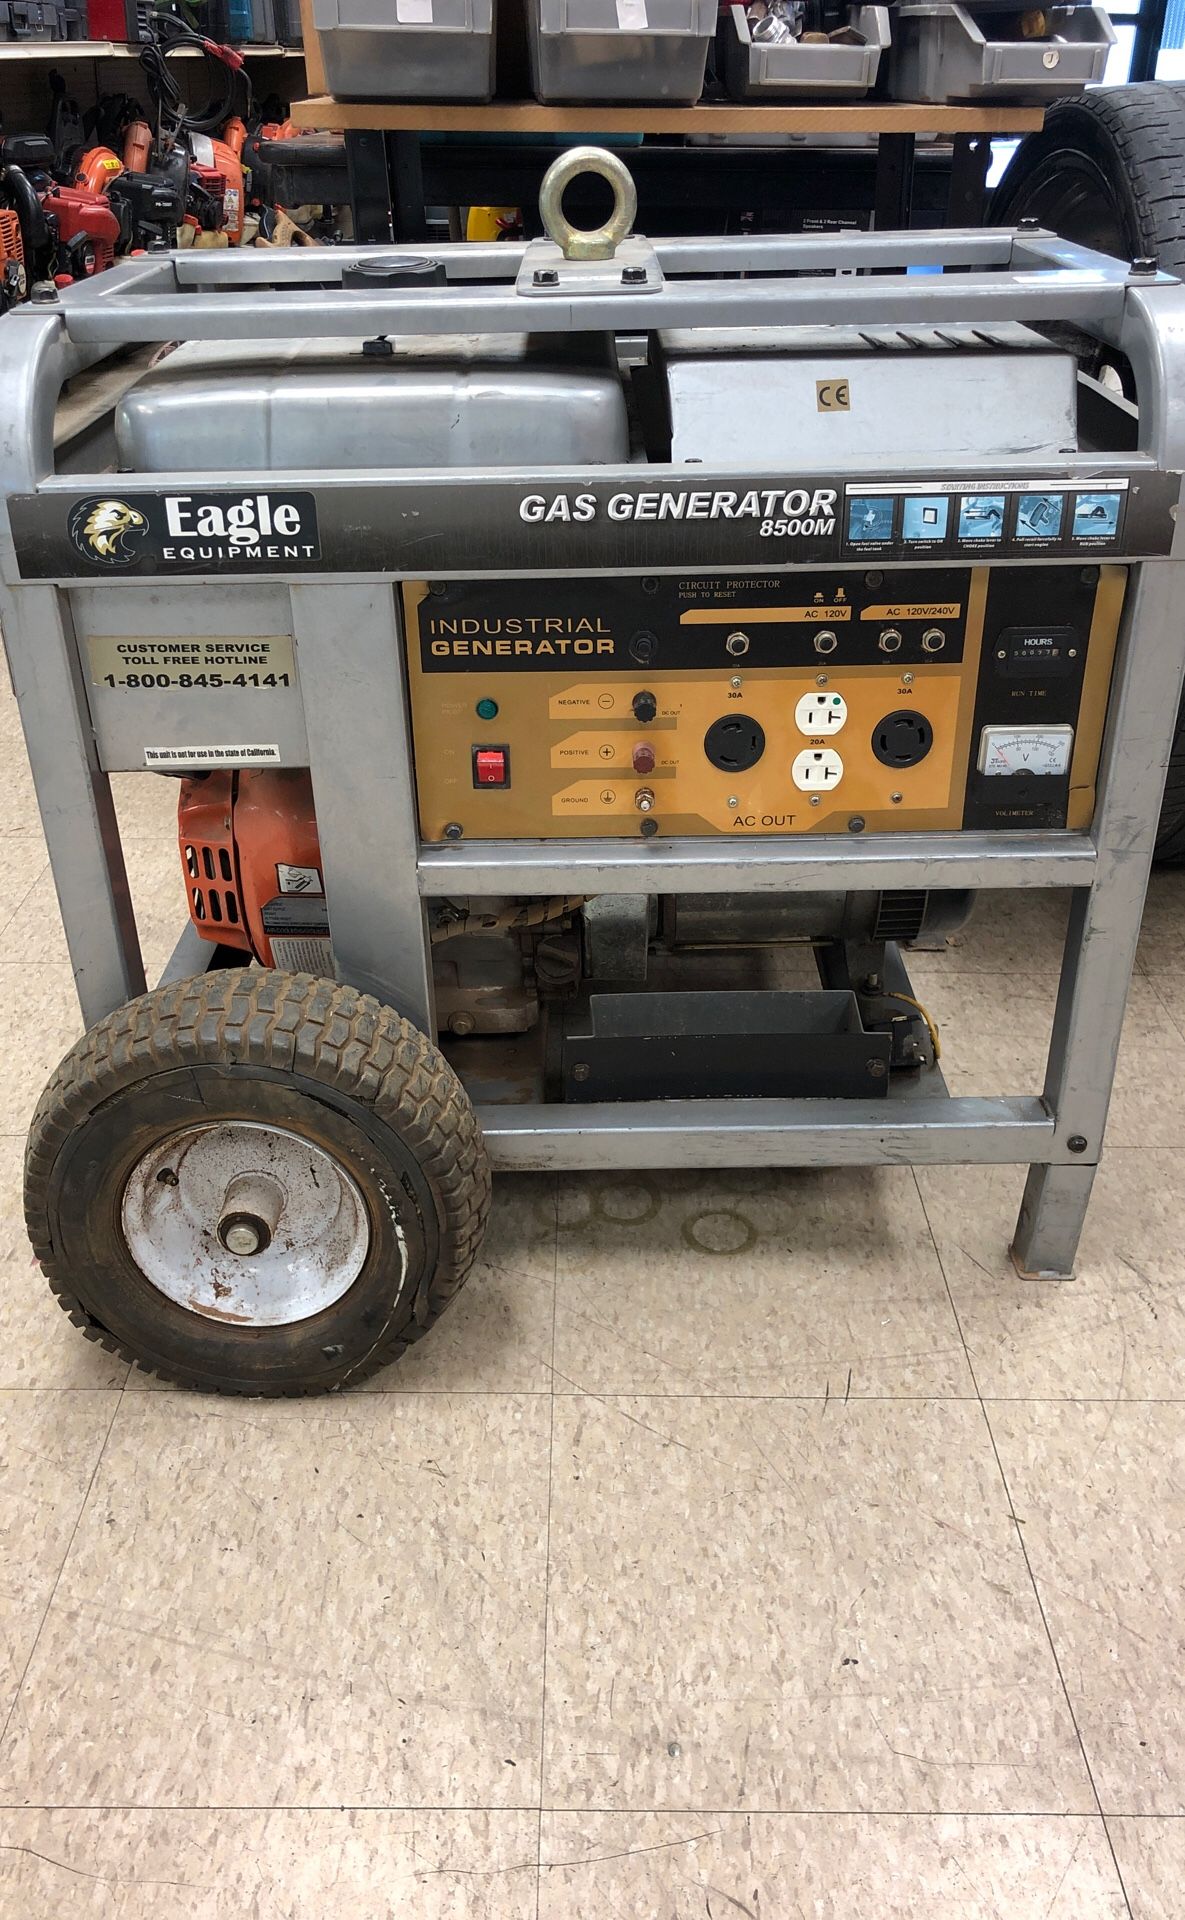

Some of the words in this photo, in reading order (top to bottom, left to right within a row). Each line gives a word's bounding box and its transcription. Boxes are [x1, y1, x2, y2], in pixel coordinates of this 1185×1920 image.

[819, 385, 848, 406] CE
[941, 483, 976, 491] STARTING
[977, 482, 1030, 490] INSTRUCTIONS
[519, 494, 597, 522] GAS
[607, 489, 838, 521] GENERATOR
[165, 495, 301, 546] Eagle
[759, 518, 836, 537] 8500M
[162, 545, 314, 560] EQUIPMENT
[679, 581, 720, 590] CIRCUIT
[726, 580, 781, 589] PROTECTOR
[804, 610, 818, 618] AC
[824, 610, 847, 618] 120V
[886, 607, 900, 616] AC
[906, 606, 955, 616] 120V/240V
[430, 618, 612, 634] INDUSTRIAL
[431, 639, 615, 655] GENERATOR
[1024, 638, 1053, 646] HOURS
[117, 644, 200, 653] CUSTOMER
[205, 643, 271, 652] SERVICE
[122, 656, 159, 665] TOLL
[163, 656, 200, 665] FREE
[204, 656, 268, 664] HOTLINE
[104, 673, 290, 688] 1-800-845-4141
[146, 751, 159, 759] This
[160, 751, 171, 759] unit
[225, 749, 240, 757] state
[1022, 753, 1030, 762] V
[733, 815, 756, 827] AC
[761, 814, 797, 826] OUT
